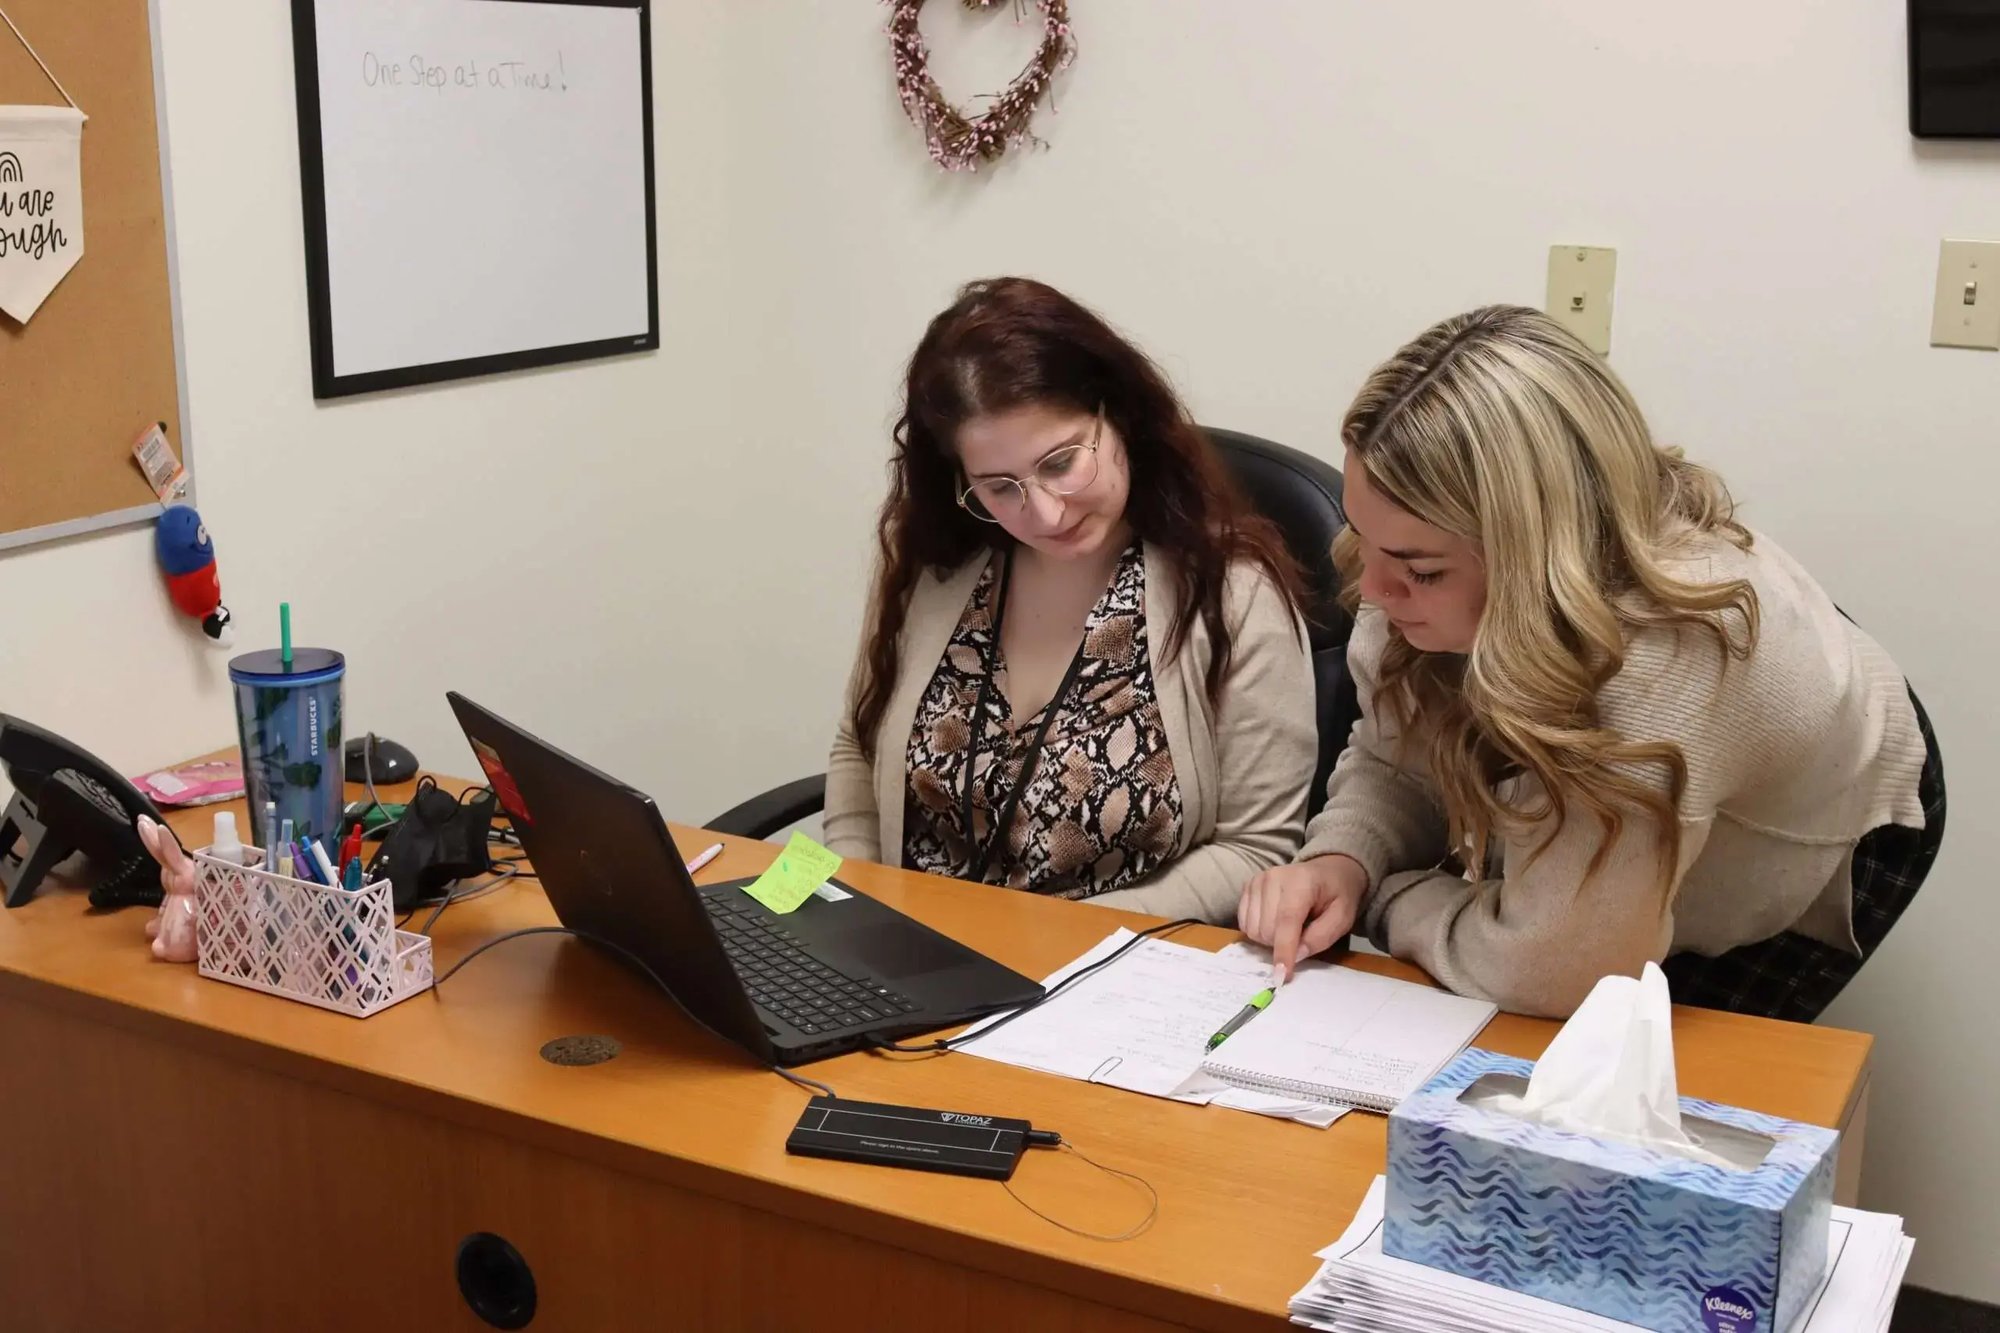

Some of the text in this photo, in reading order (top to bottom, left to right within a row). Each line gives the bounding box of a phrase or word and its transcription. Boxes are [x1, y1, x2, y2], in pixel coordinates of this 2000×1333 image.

[363, 51, 402, 87] One
[409, 54, 447, 95] Step
[454, 59, 480, 88] at
[488, 67, 506, 88] a
[19, 189, 54, 217] are
[310, 698, 318, 756] STARBUCKS
[955, 1113, 993, 1125] TOPAZ
[1705, 1297, 1754, 1320] Kleenex
